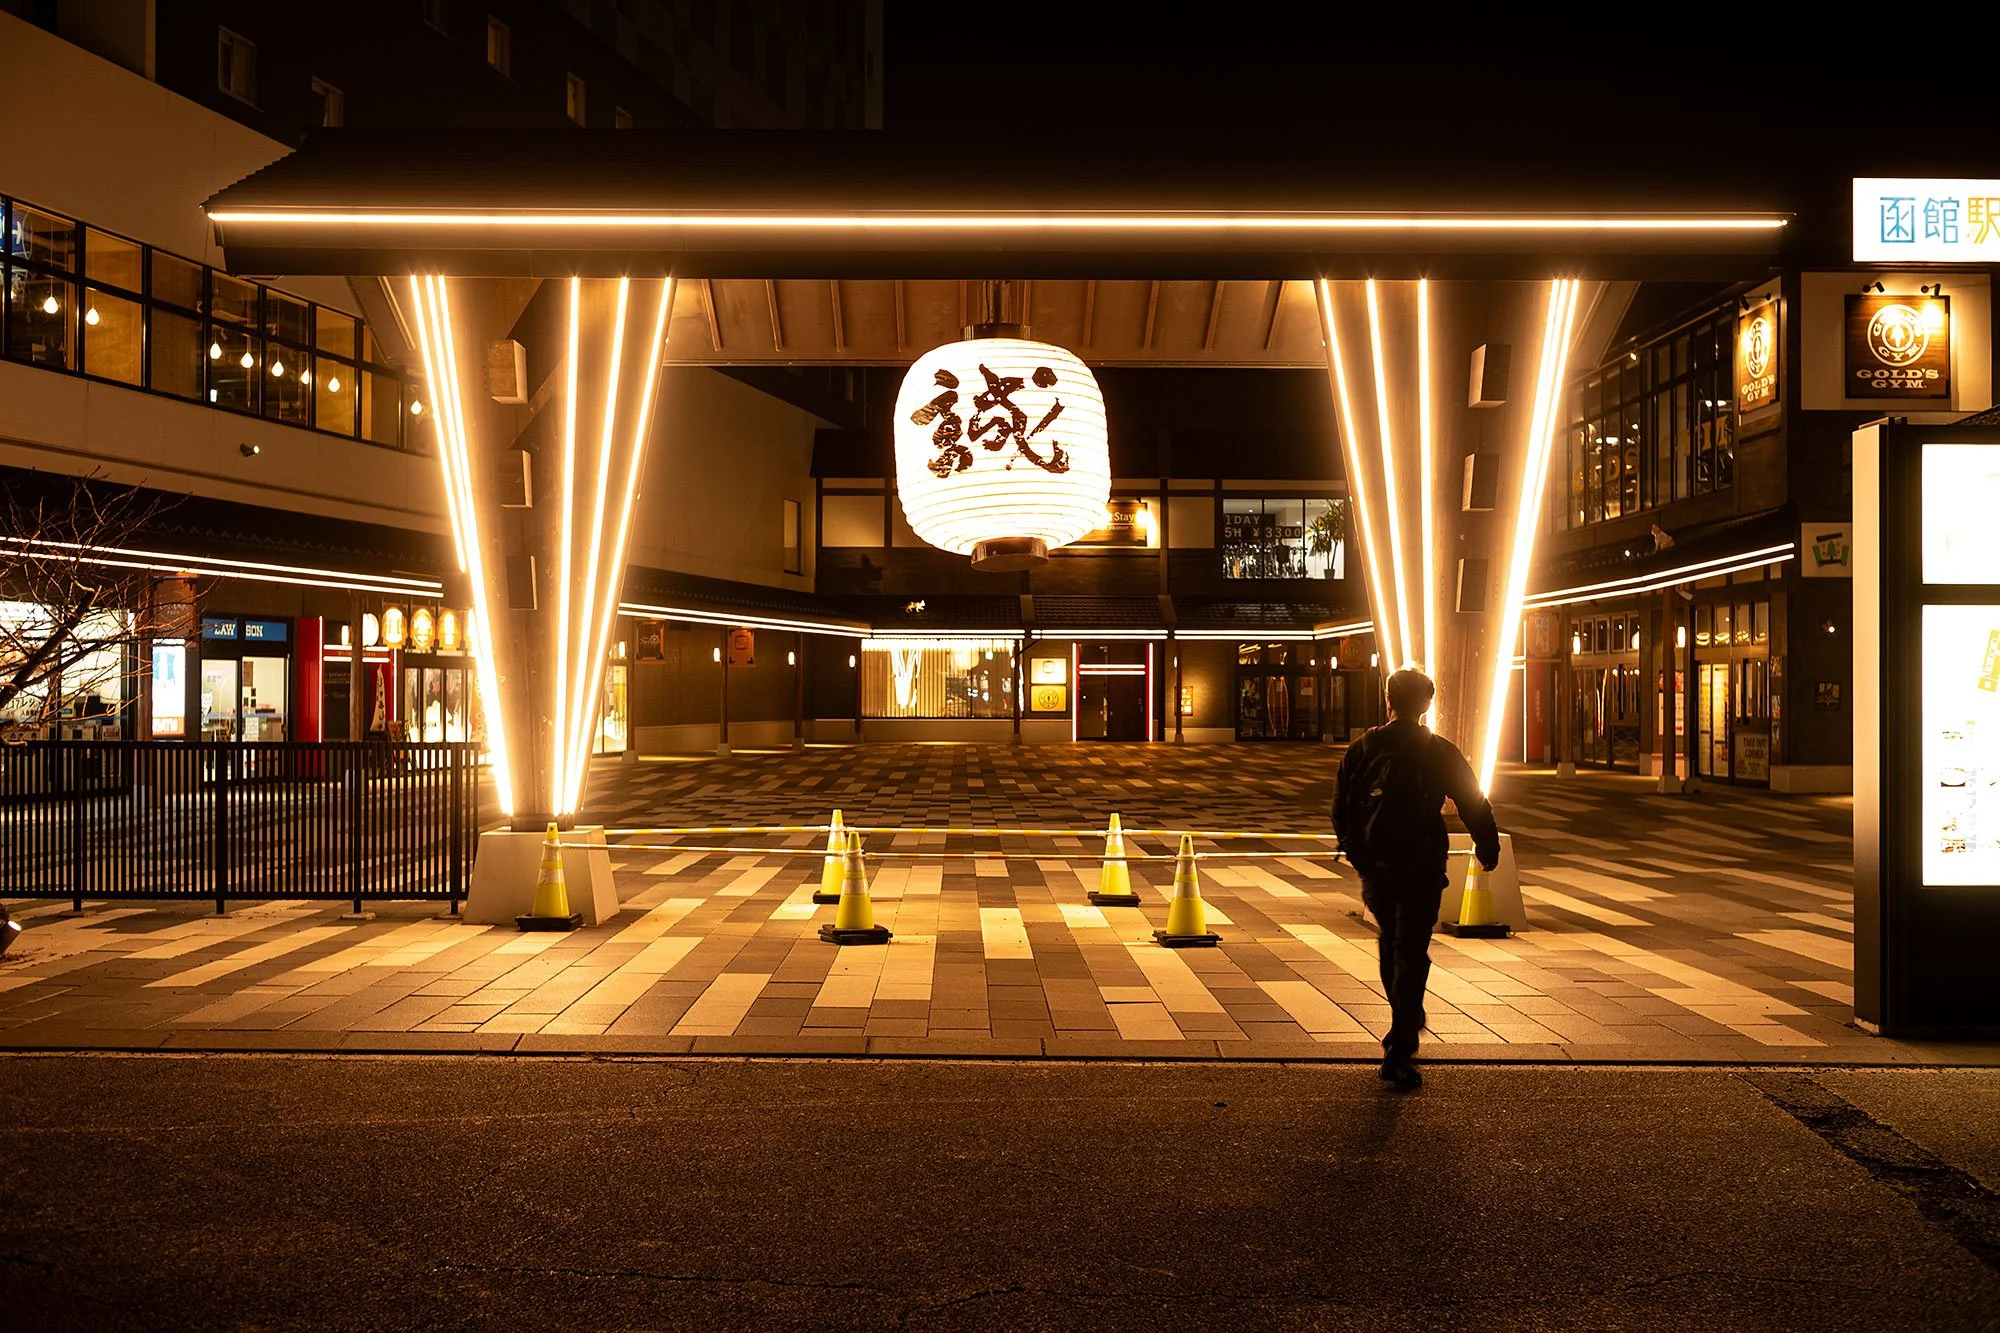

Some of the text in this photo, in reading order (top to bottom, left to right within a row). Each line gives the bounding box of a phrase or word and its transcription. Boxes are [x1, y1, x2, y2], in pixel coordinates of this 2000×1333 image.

[1856, 368, 1939, 379] GOLD'S
[1747, 386, 1769, 402] GYM
[1114, 511, 1134, 522] Stay
[1225, 514, 1260, 525] 1DAY
[1224, 527, 1242, 538] 5H
